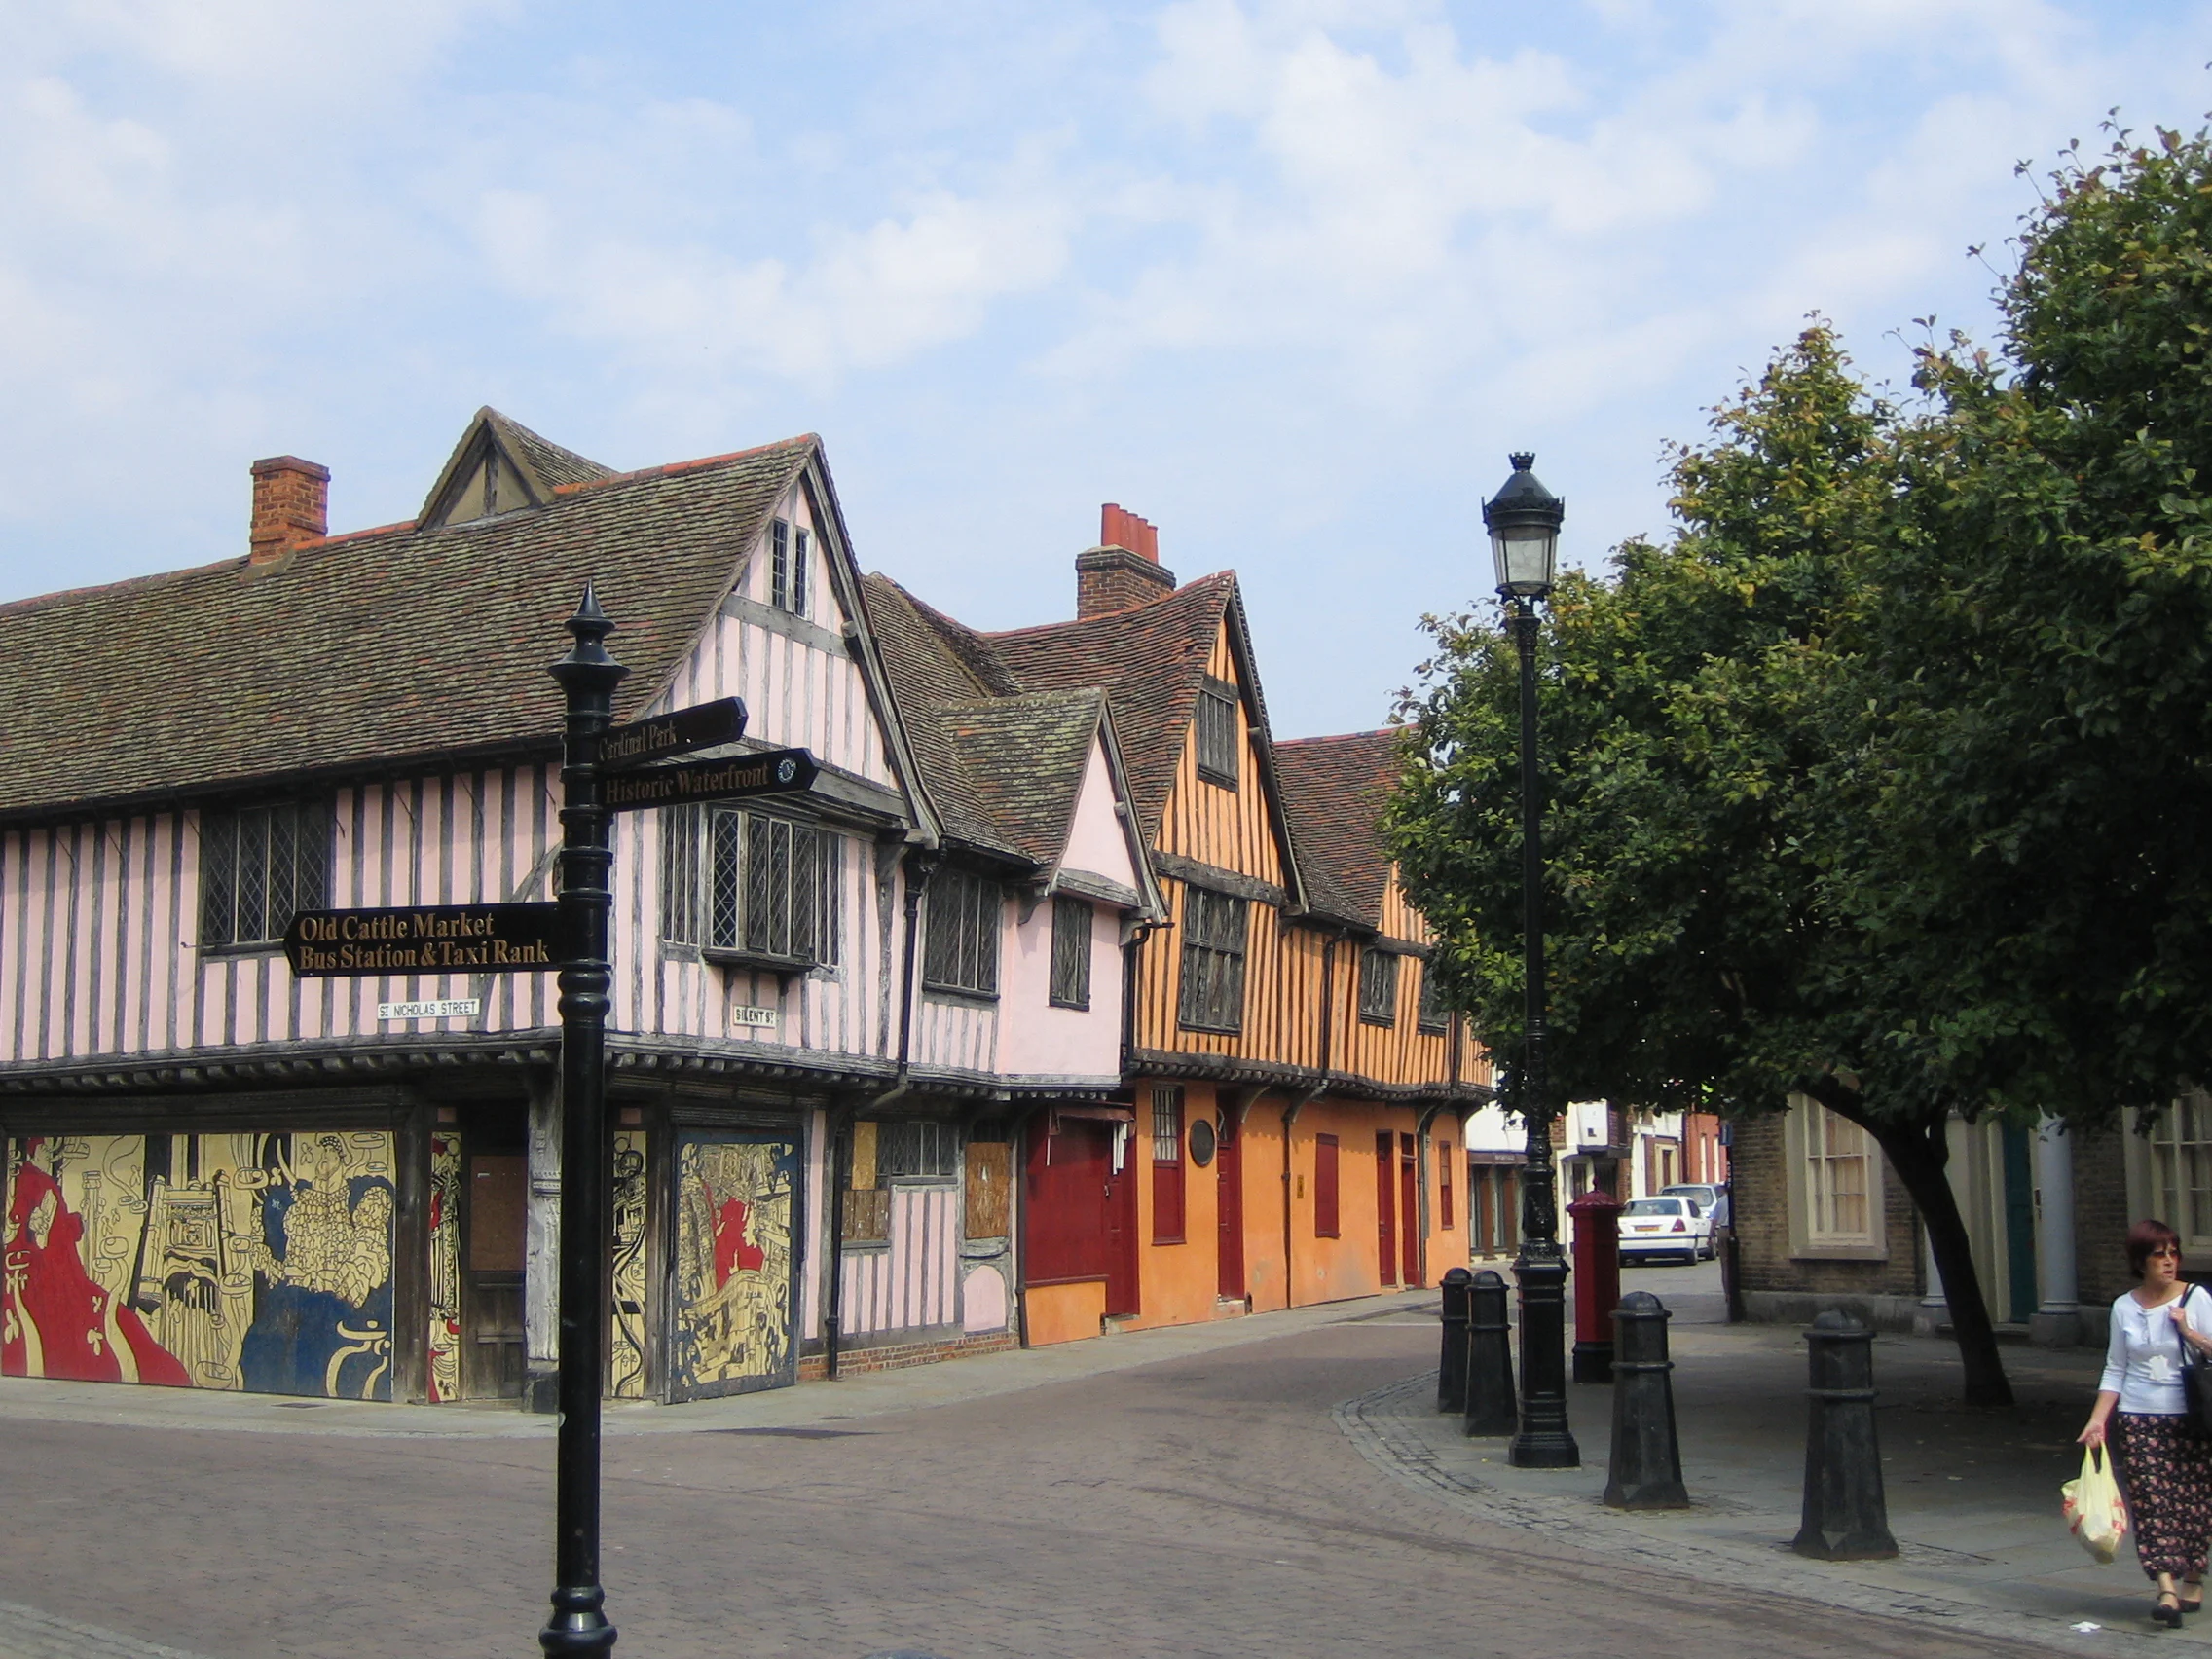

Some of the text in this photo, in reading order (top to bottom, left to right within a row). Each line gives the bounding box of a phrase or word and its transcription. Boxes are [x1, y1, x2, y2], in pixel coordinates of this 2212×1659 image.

[599, 719, 677, 761] Cardinal Park
[605, 775, 674, 804] Historic
[676, 762, 770, 795] Waterfront
[299, 912, 495, 941] Old Cattle Market
[299, 939, 550, 970] Bus Station & Taxi Rank
[394, 1004, 435, 1016] NICHOLAS
[441, 1001, 476, 1014] STREET
[736, 1008, 764, 1023] SILENT
